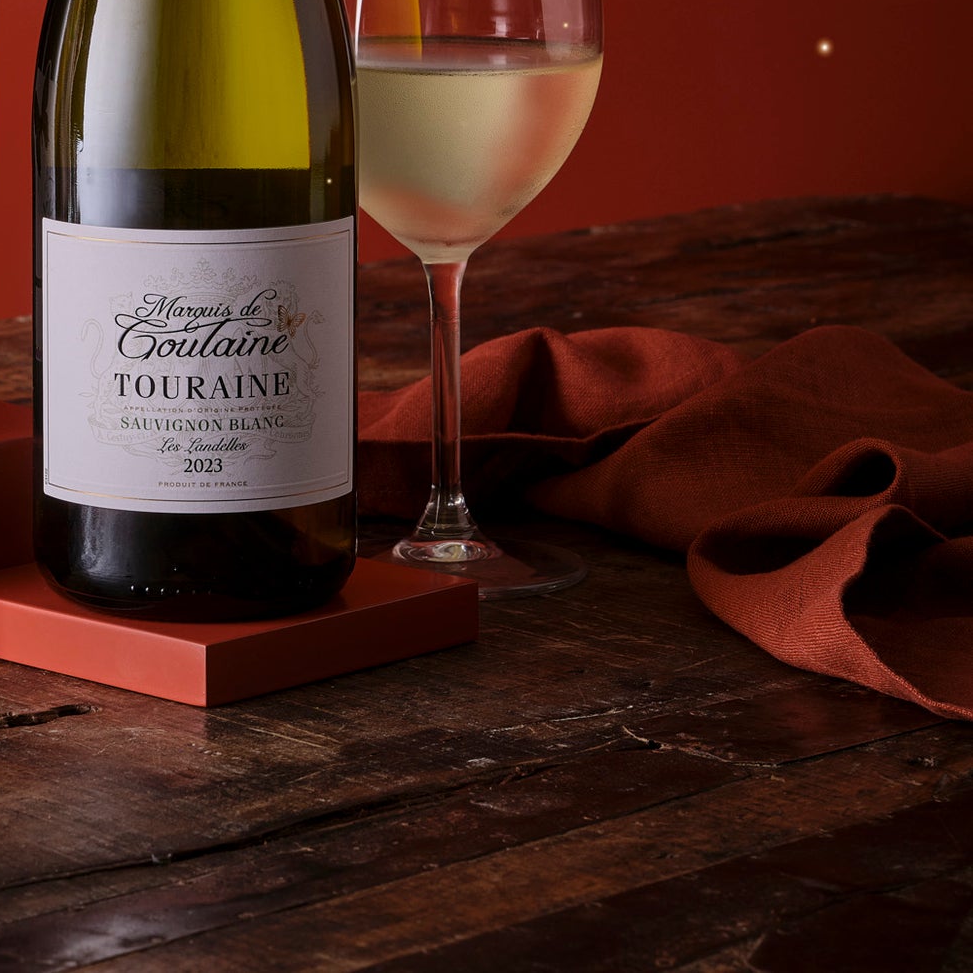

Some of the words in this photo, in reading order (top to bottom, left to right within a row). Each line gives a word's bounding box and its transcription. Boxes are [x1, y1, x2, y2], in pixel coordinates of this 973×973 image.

[134, 293, 233, 333] Marquis
[239, 288, 277, 316] de
[114, 313, 290, 362] Goulaine
[113, 371, 291, 400] TOURAINE
[120, 416, 223, 432] SAUVIGNON
[229, 414, 285, 431] BLANC
[157, 436, 182, 454] Les
[183, 436, 251, 455] Landelles
[183, 458, 224, 474] 2023
[158, 480, 196, 488] PRODUIT
[200, 480, 212, 488] DE
[214, 480, 249, 488] FRANCE
